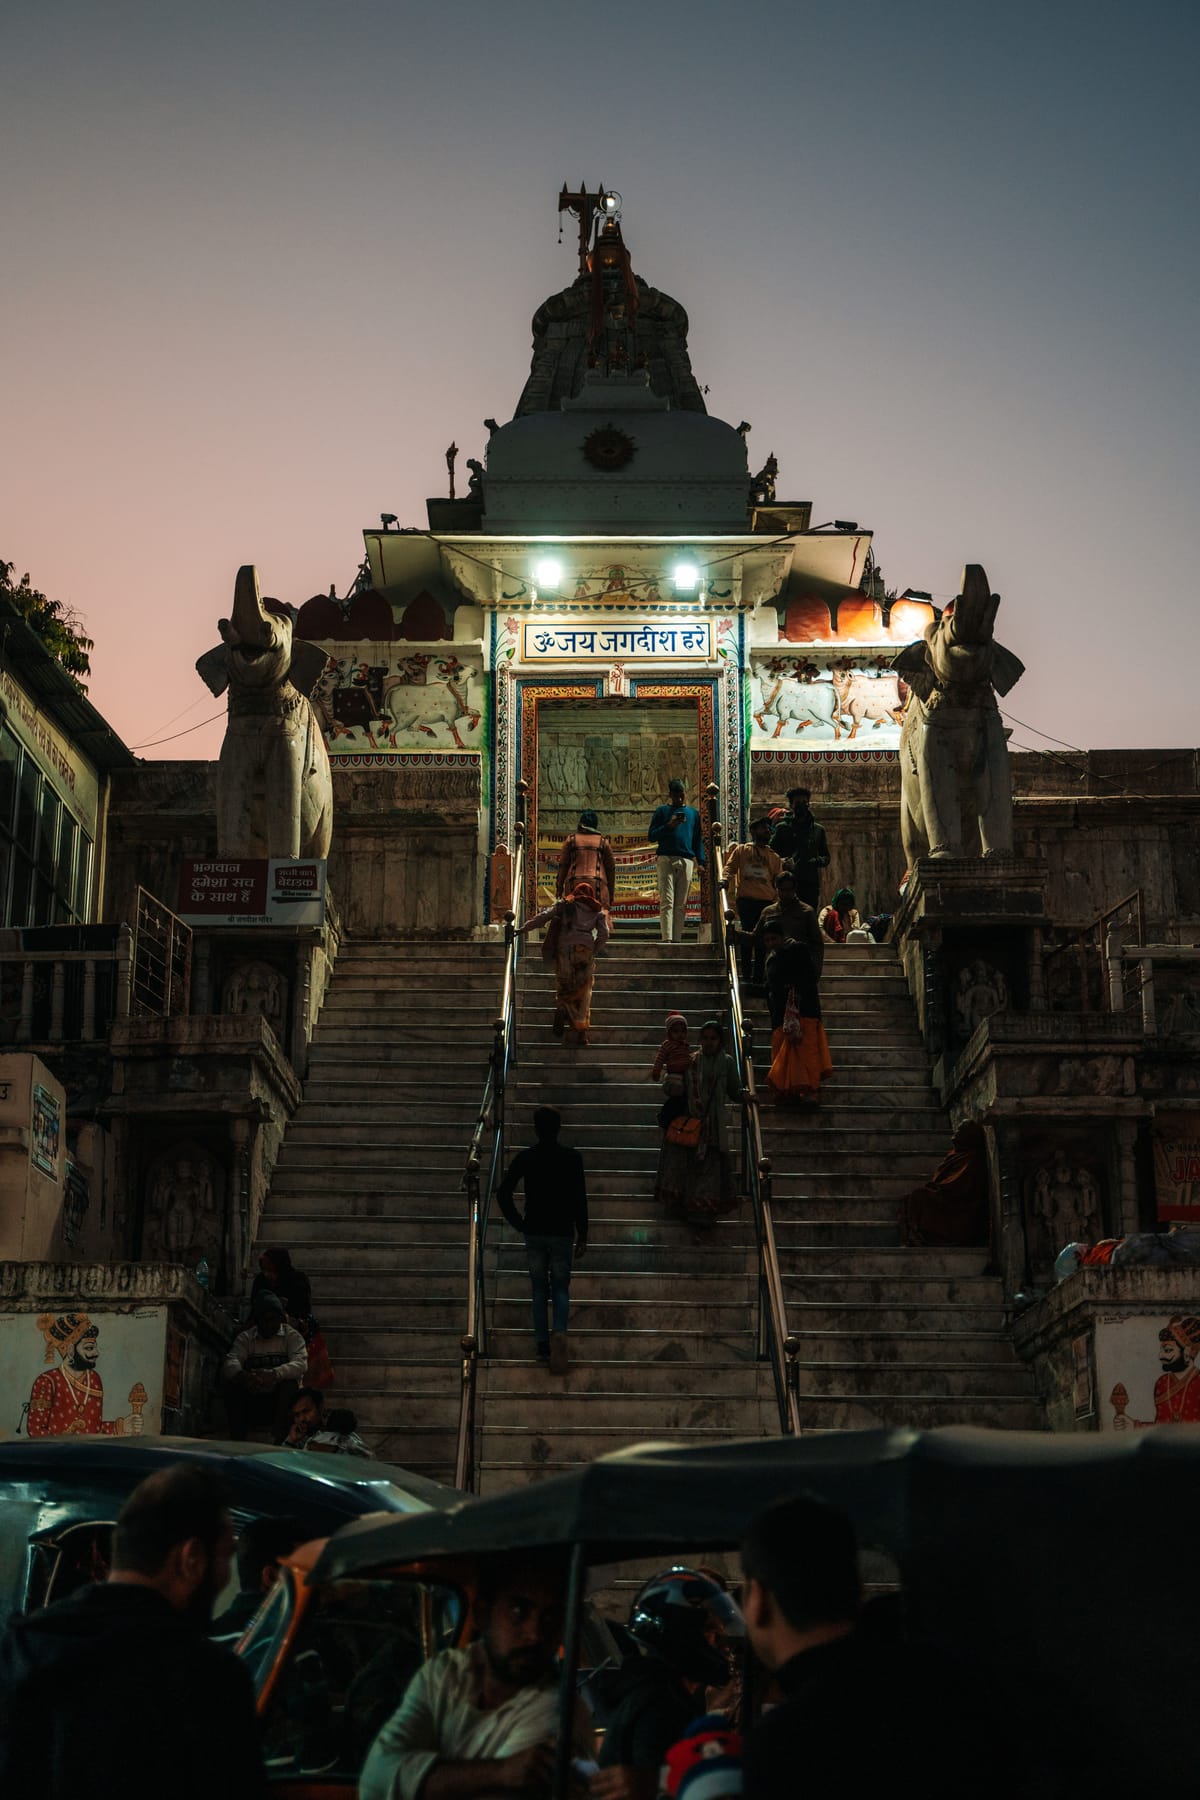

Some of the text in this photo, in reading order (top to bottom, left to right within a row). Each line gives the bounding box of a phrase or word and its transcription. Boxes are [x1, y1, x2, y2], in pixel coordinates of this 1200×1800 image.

[555, 631, 597, 653] जय
[599, 626, 677, 652] जगदीश
[680, 625, 706, 652] हरे
[193, 863, 241, 873] भगवान
[191, 875, 256, 888] हमेशा सच
[191, 889, 206, 902] के
[209, 892, 238, 903] साथ
